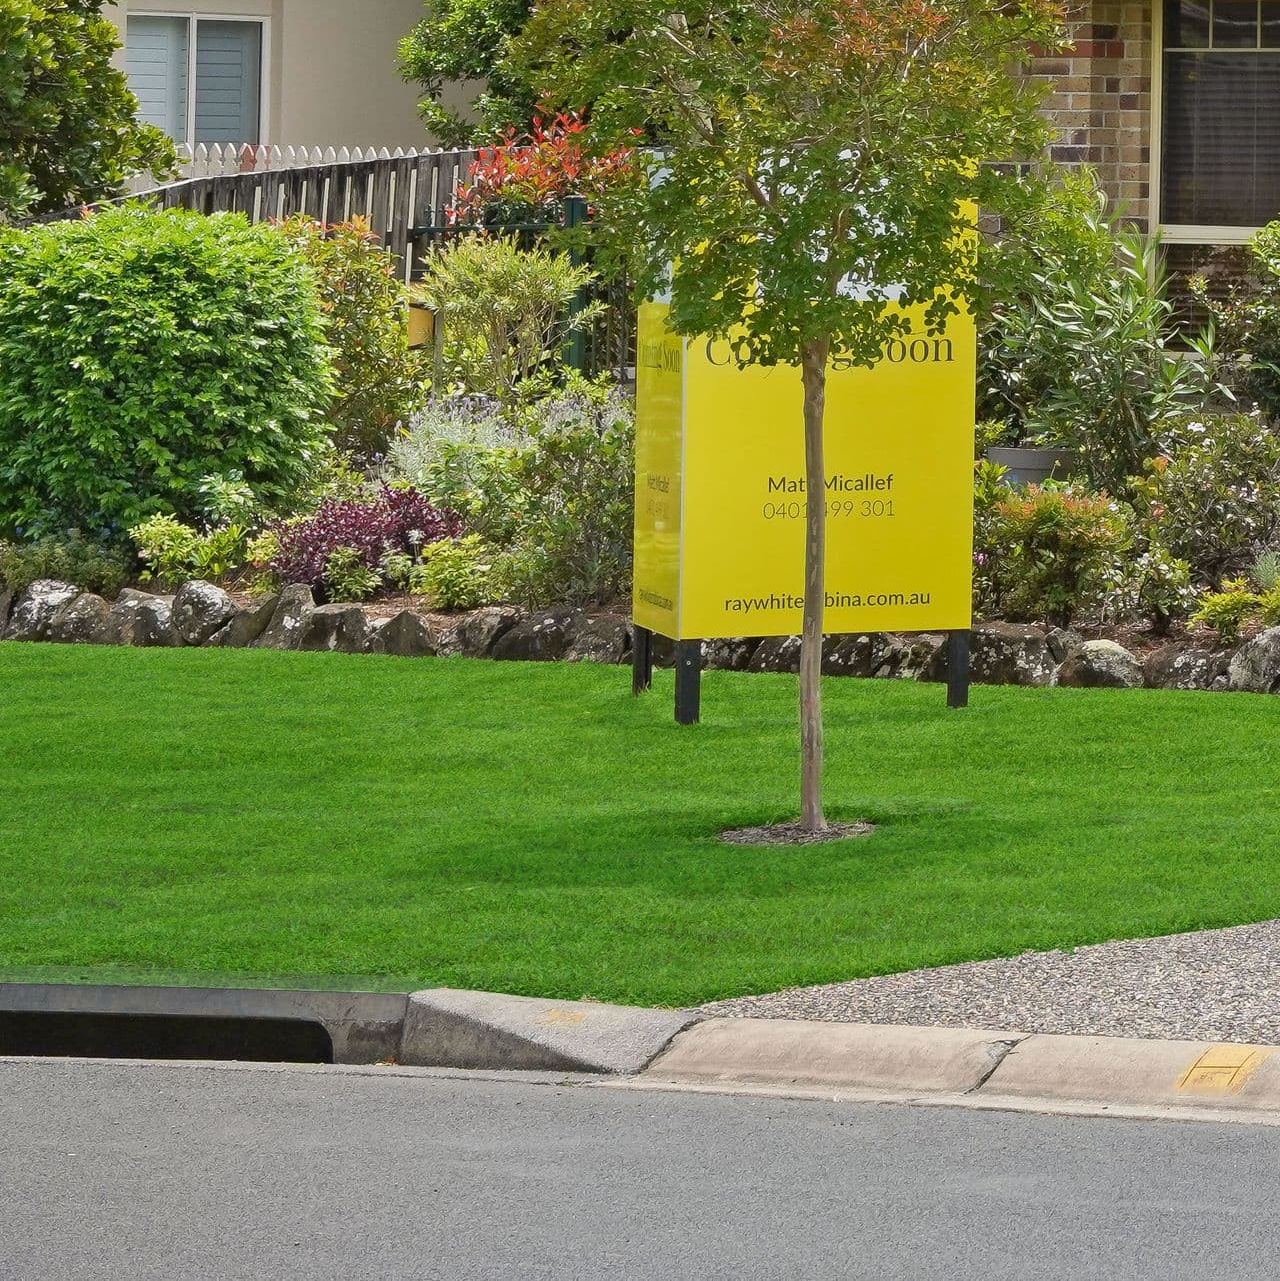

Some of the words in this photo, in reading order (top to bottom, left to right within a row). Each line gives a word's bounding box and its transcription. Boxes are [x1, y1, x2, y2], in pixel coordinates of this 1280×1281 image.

[861, 333, 955, 364] oon
[768, 475, 808, 493] Mat
[860, 499, 895, 517] 301
[725, 592, 931, 614] raywhitebina.com.au
